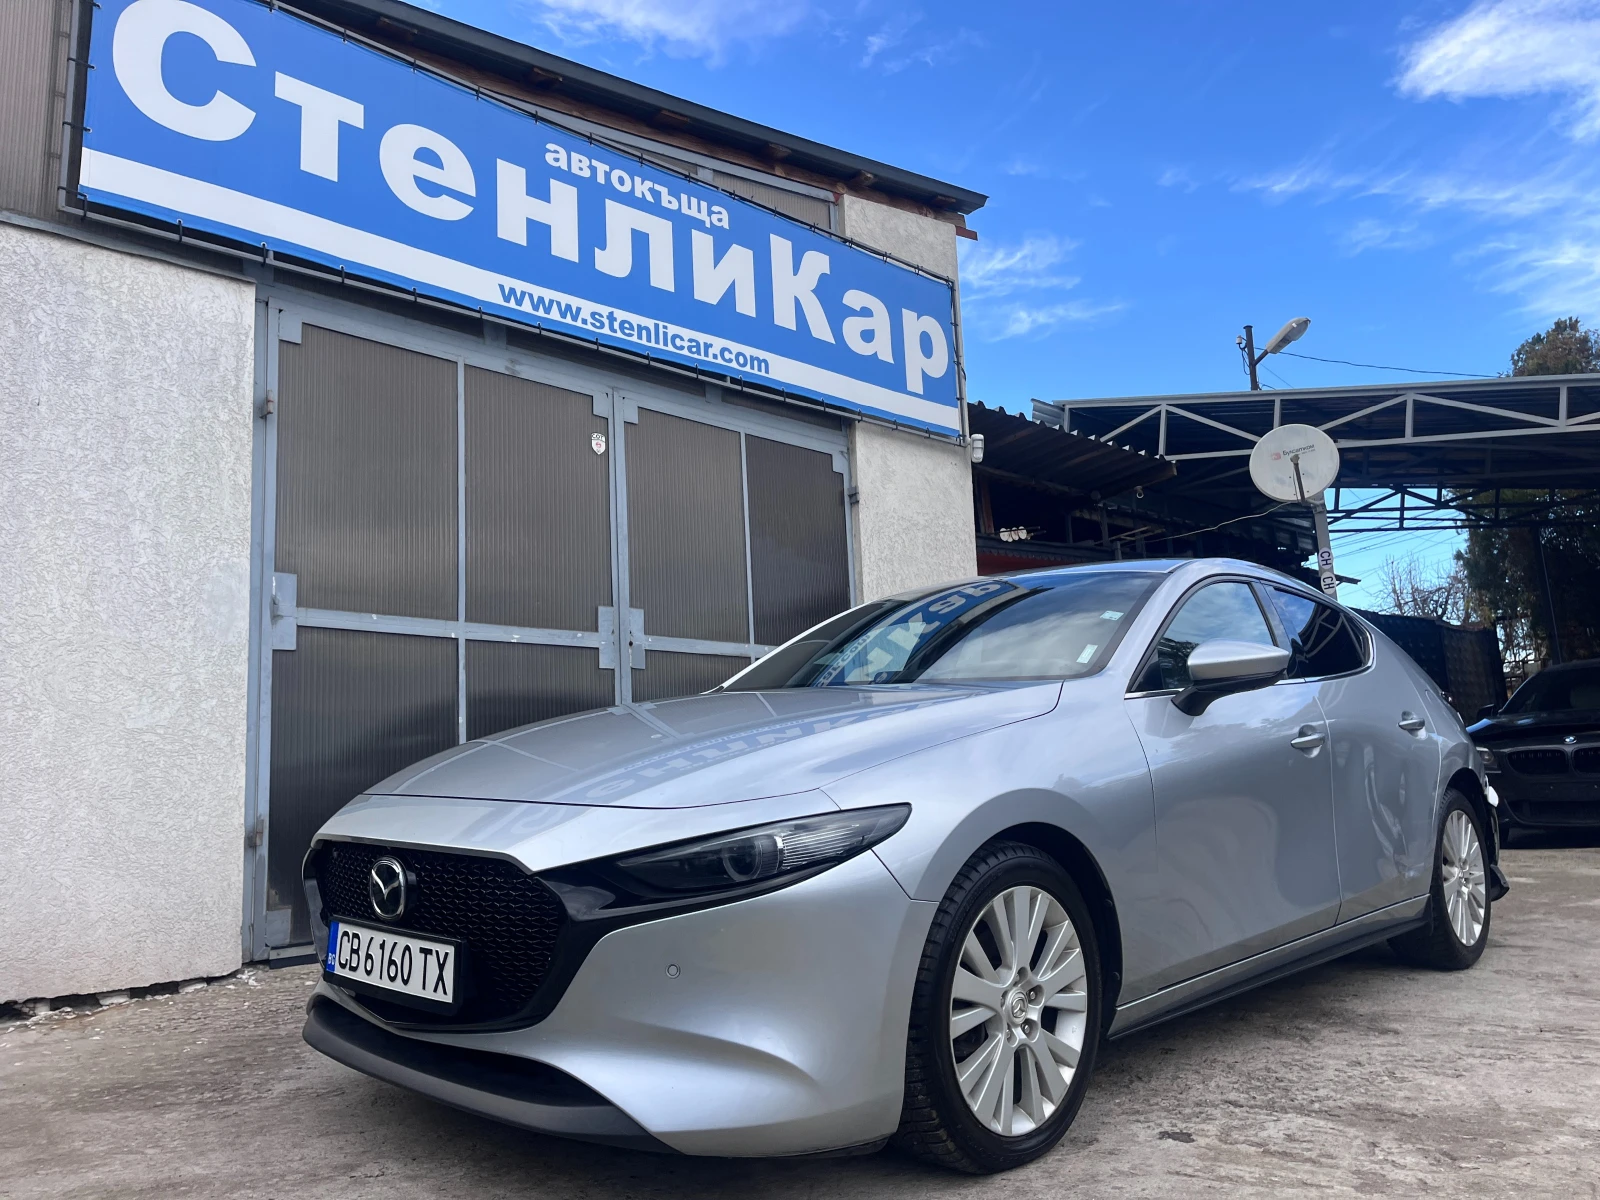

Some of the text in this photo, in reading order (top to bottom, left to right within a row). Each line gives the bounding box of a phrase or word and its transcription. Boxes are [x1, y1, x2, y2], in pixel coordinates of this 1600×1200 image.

[112, 0, 949, 395] СтенлиКар
[544, 142, 730, 230] автокъща
[497, 283, 770, 375] www.stenlicar.com
[1320, 550, 1332, 566] CH
[1322, 576, 1335, 590] CH
